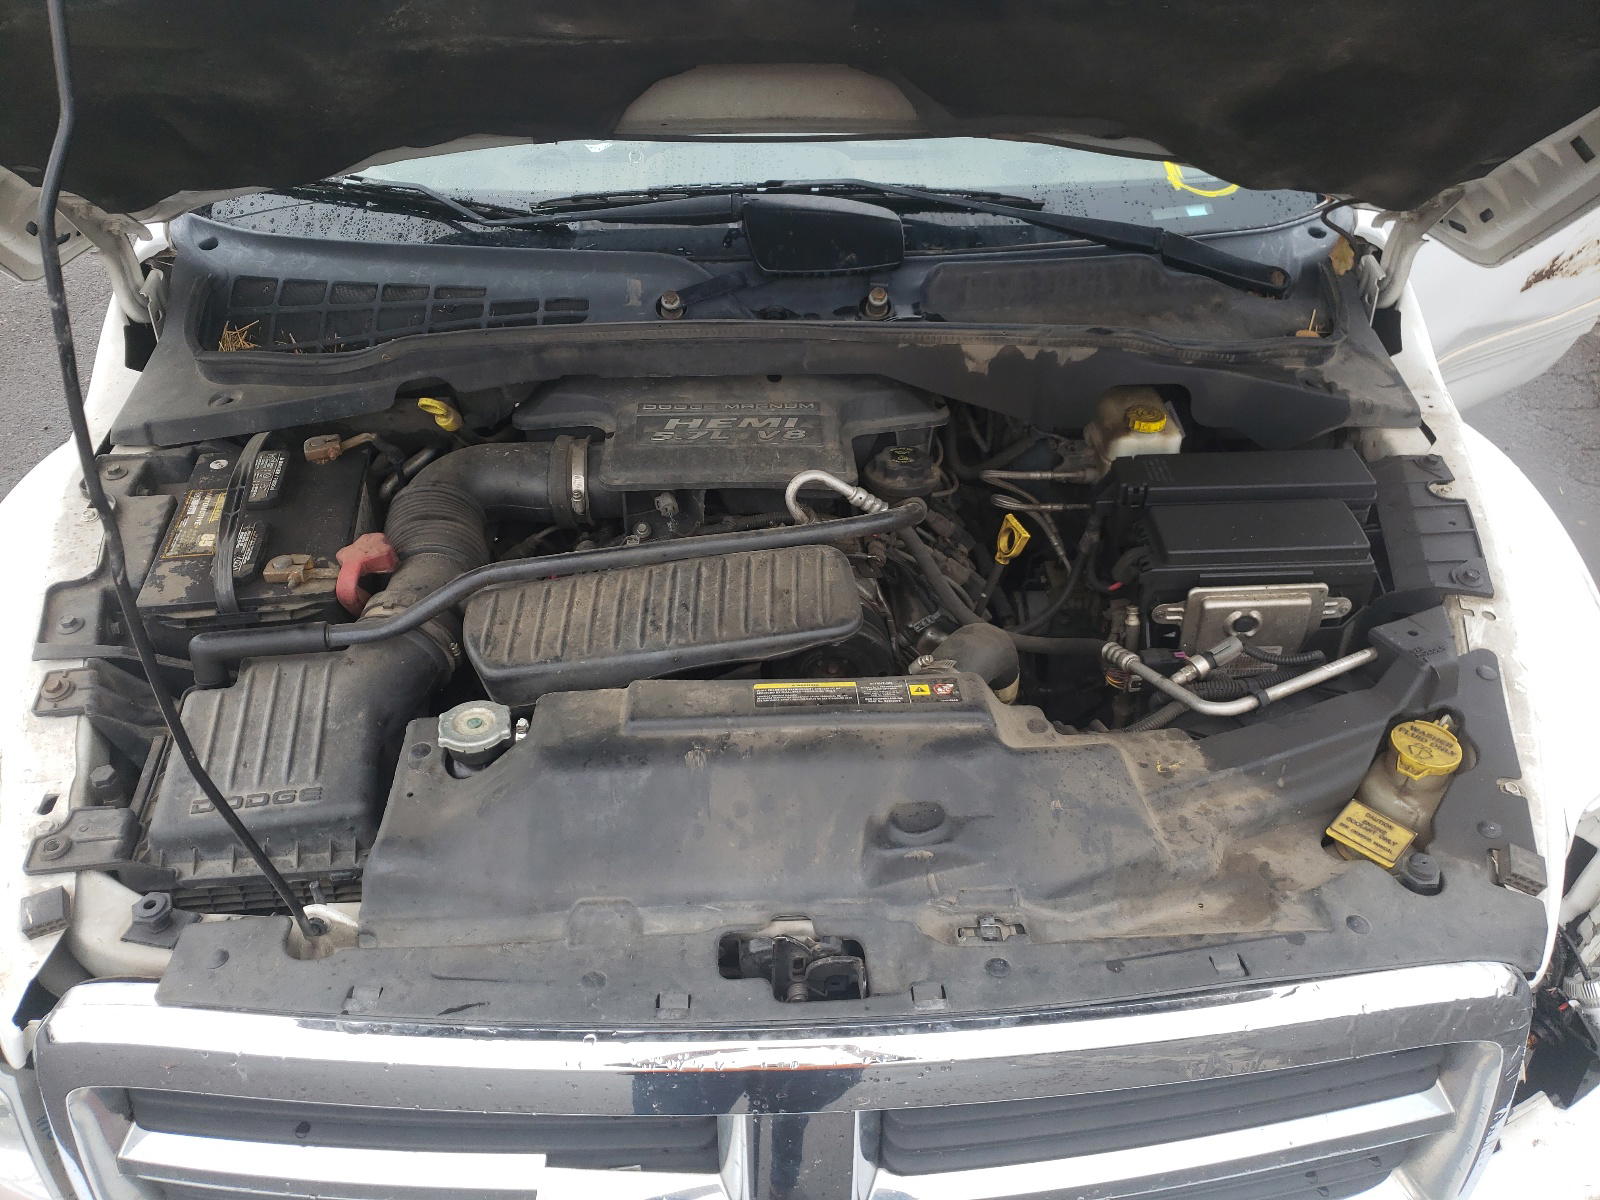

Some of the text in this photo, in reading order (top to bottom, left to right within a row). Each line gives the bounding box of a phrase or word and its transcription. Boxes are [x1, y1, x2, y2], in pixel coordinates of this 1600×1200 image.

[663, 417, 799, 430] HEMI
[650, 429, 807, 442] 5.7L V8
[1398, 726, 1428, 743] FLUID
[1409, 724, 1454, 749] WASHER
[190, 787, 323, 814] DODGE
